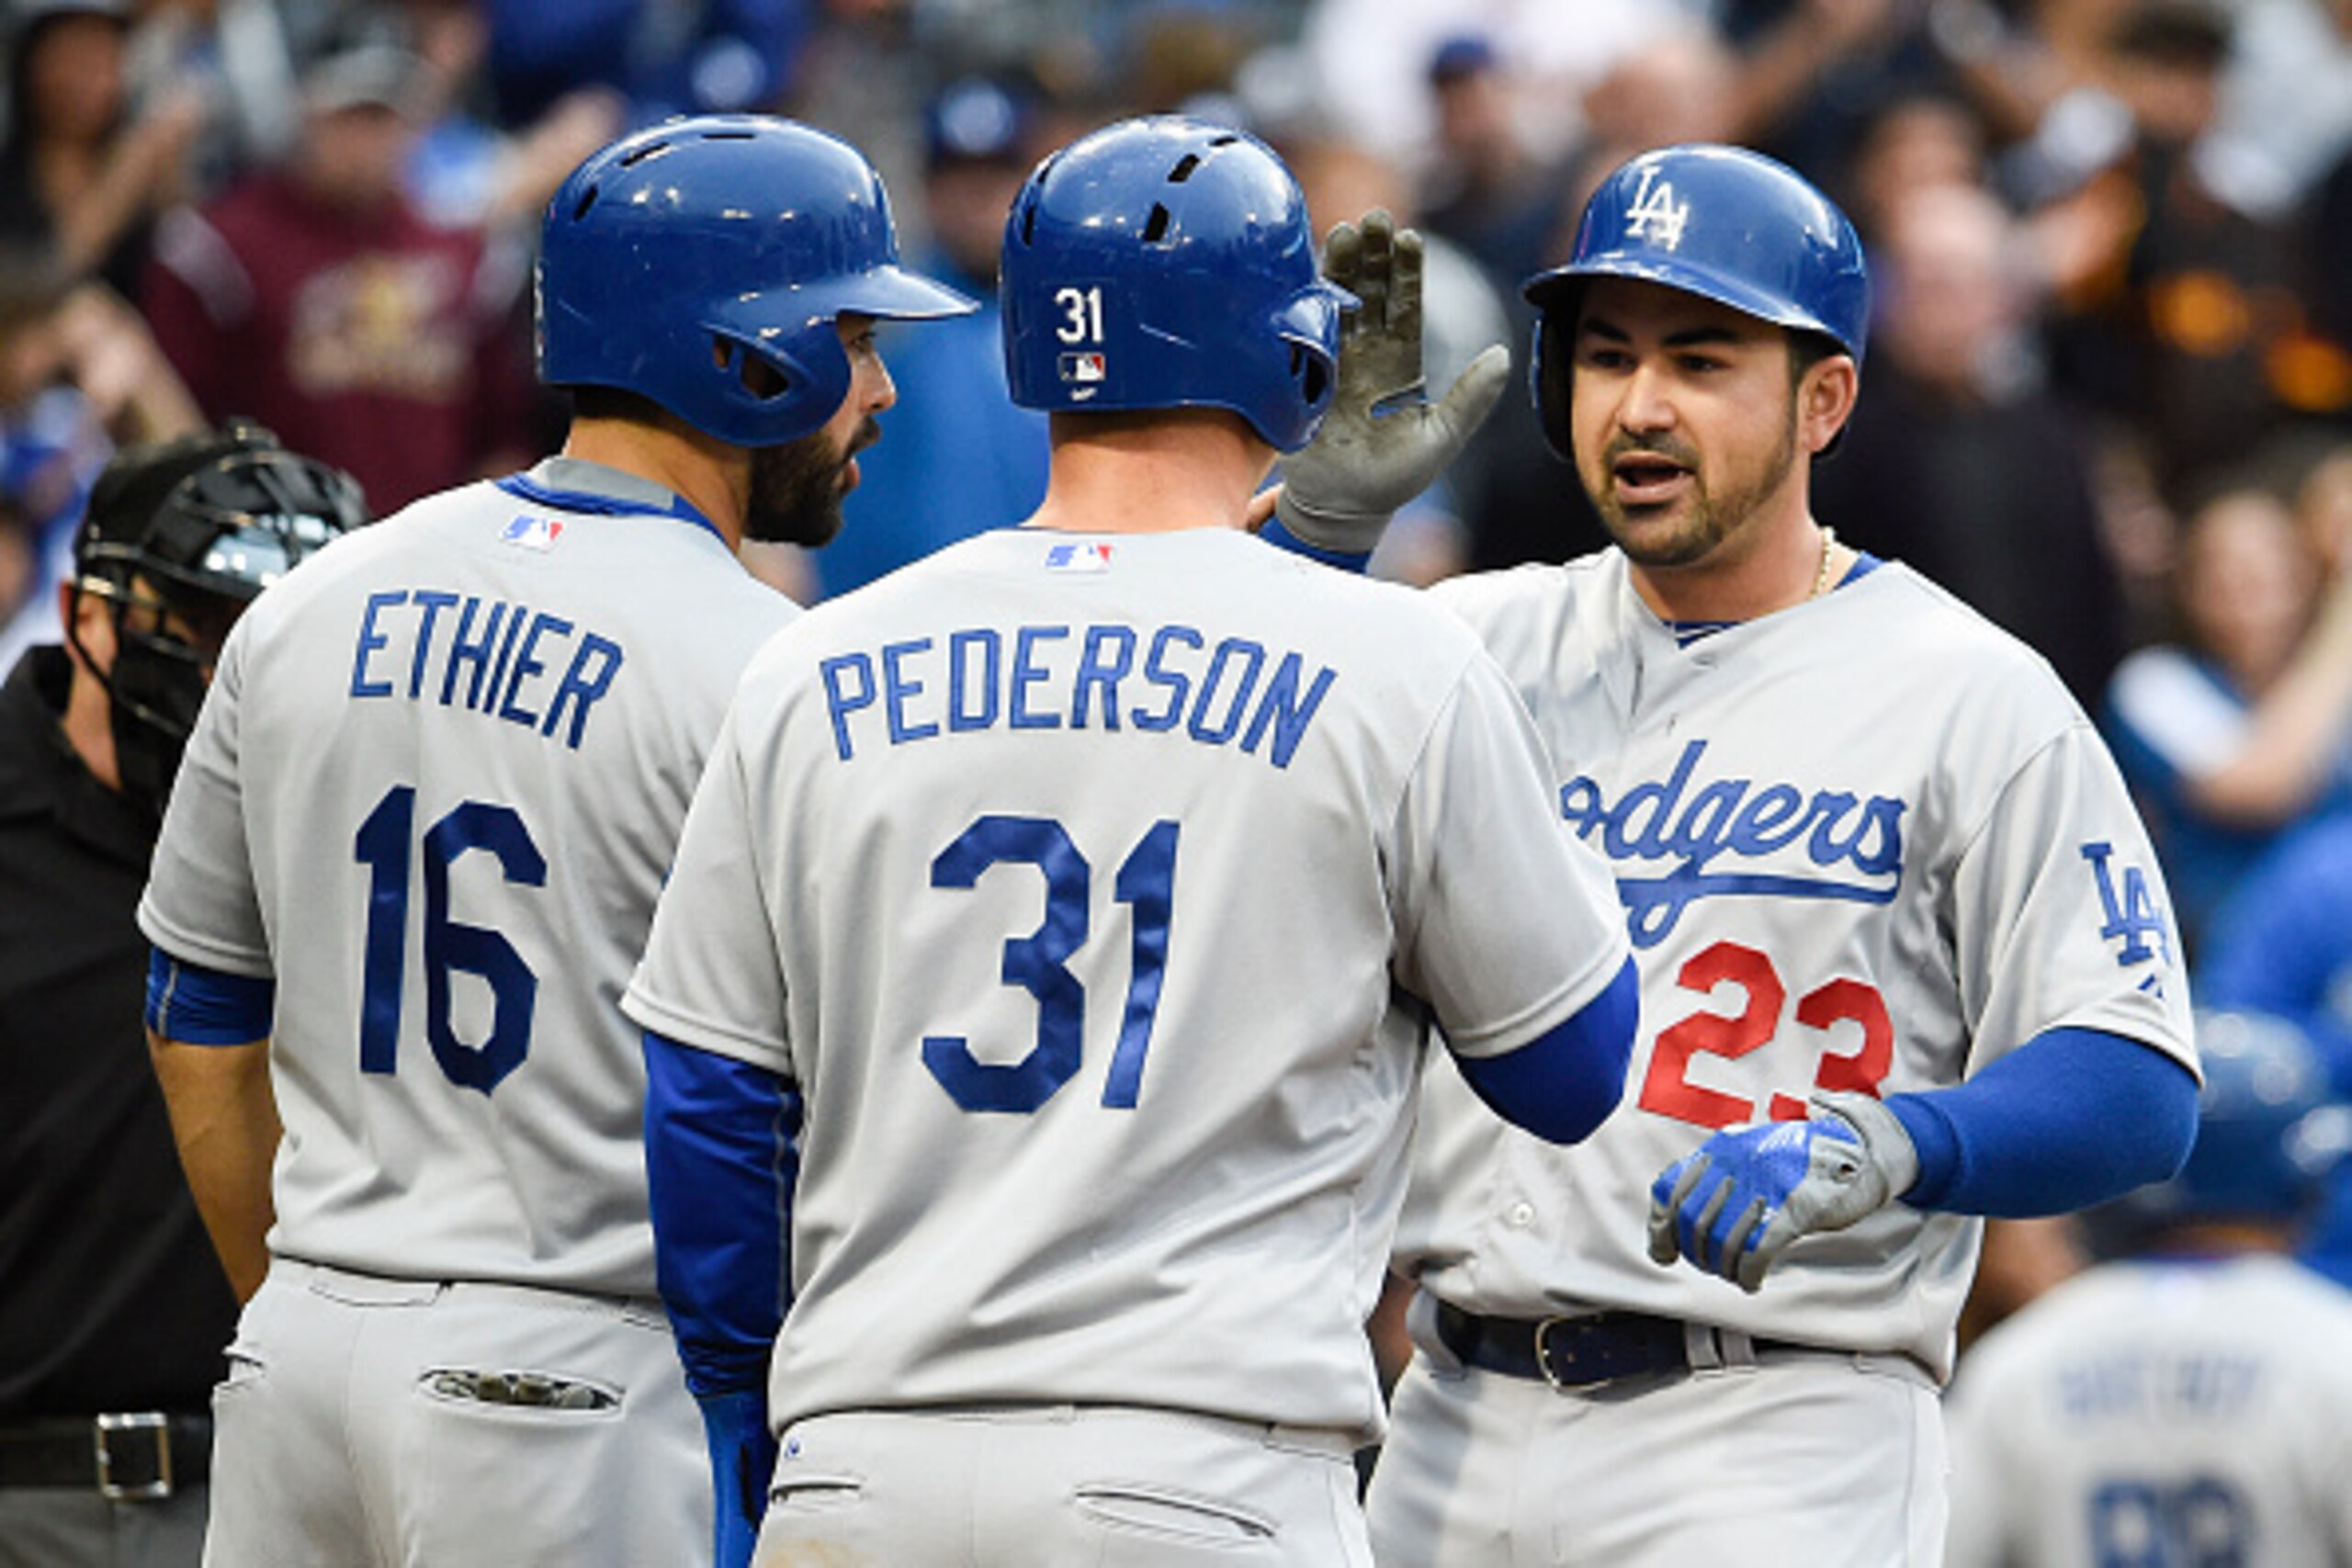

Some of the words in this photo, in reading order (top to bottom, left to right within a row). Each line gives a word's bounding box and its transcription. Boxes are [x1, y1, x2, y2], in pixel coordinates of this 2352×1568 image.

[1625, 164, 1689, 252] LA
[1054, 286, 1103, 344] 31
[348, 589, 623, 750] ETHIER
[820, 626, 1338, 769] PEDERSON
[1560, 740, 1906, 949] odgers
[2081, 842, 2173, 966] LA
[355, 784, 548, 1099] 16
[922, 815, 1181, 1114] 31
[1638, 941, 1894, 1129] 23
